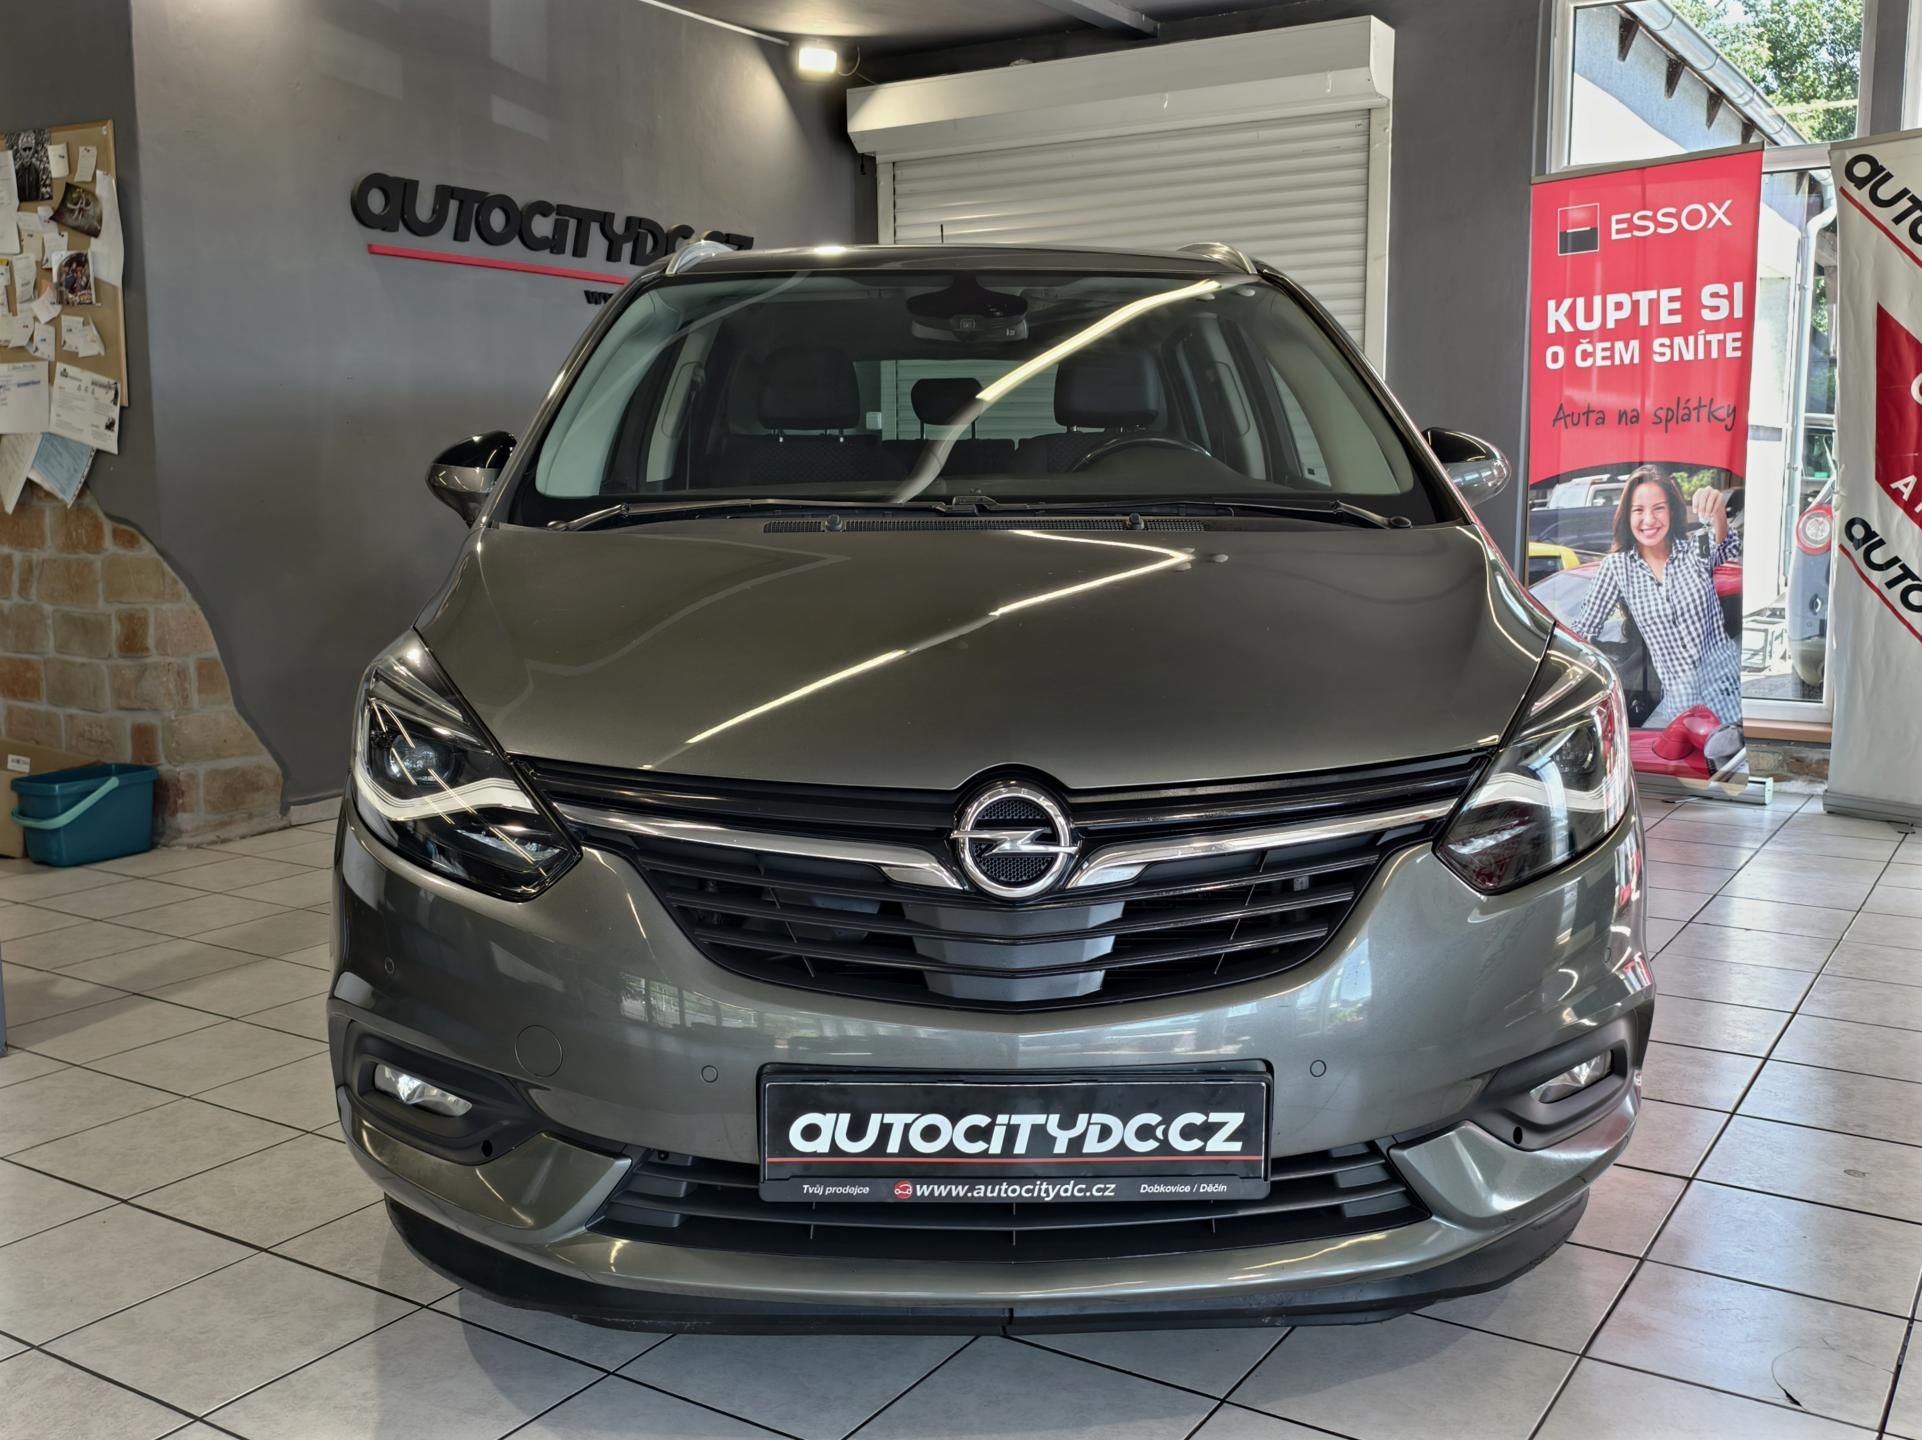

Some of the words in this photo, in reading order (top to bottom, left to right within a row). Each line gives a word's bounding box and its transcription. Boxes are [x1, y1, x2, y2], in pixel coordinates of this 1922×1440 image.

[1610, 199, 1733, 241] ESSOX
[1546, 287, 1683, 335] KUPTE
[1700, 281, 1744, 321] SI
[1545, 346, 1565, 370] O
[1575, 338, 1640, 368] ČEM
[1652, 331, 1743, 363] SNÍTE
[1552, 403, 1606, 428] Auta
[1617, 409, 1640, 426] na
[1651, 395, 1737, 433] splátky
[803, 1184, 823, 1196] Tvůj
[825, 1184, 870, 1196] prodejce
[915, 1180, 1117, 1201] www.autocitydc.cz
[1140, 1183, 1191, 1194] Dobkovice
[1199, 1182, 1228, 1193] Děčín
